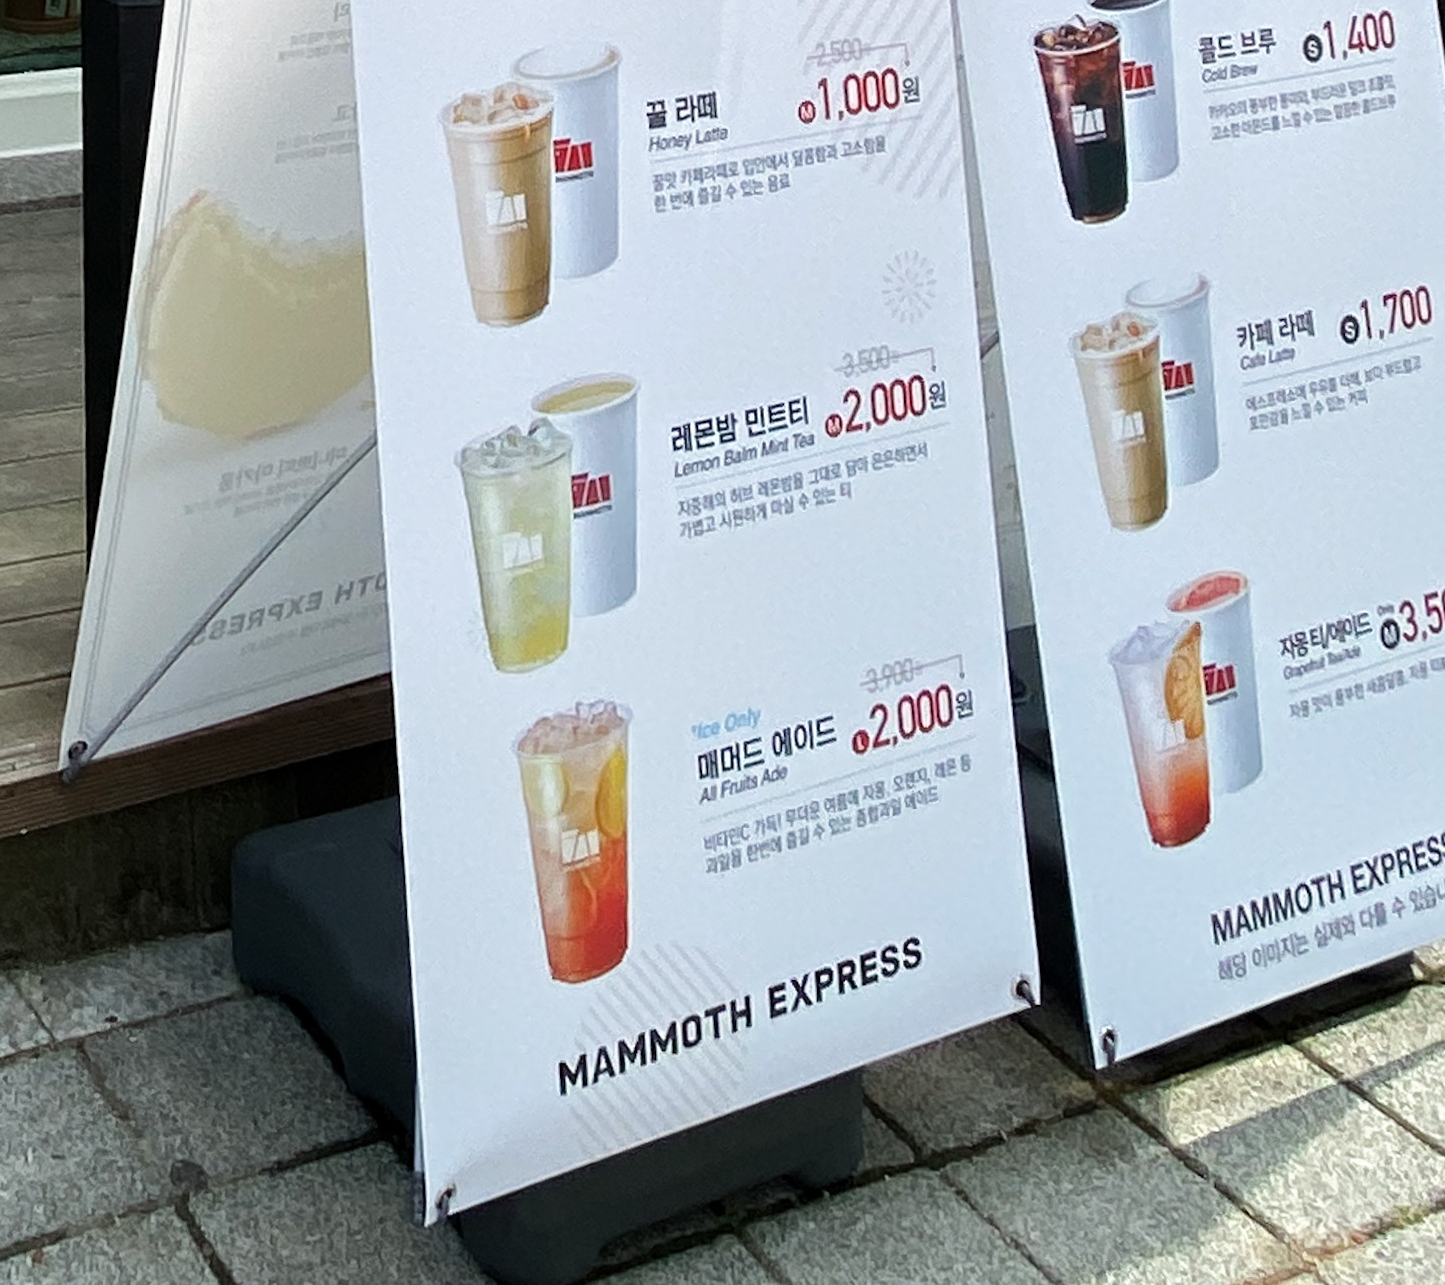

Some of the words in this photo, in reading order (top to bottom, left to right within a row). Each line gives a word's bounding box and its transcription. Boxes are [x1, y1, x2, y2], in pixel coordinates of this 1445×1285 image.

[1198, 35, 1236, 64] 콜드
[1240, 28, 1277, 55] 브루
[1323, 10, 1396, 60] 1,400
[1202, 66, 1228, 84] Cold
[1231, 63, 1258, 79] Brew
[646, 100, 668, 129] 꿀
[675, 91, 718, 123] 라떼
[648, 130, 691, 152] Honey
[724, 183, 736, 201] 수
[1236, 317, 1274, 351] 카페
[1278, 310, 1315, 343] 라떼
[1359, 285, 1434, 341] 1,700
[671, 413, 738, 453] 레몬밤
[745, 396, 809, 438] 민트티
[674, 452, 720, 479] Lemon
[724, 444, 758, 467] Balm
[761, 436, 790, 459] Mint
[793, 430, 816, 451] Tea
[798, 492, 810, 512] 수
[1399, 591, 1445, 642] 3,5
[1279, 631, 1309, 660] 자몽
[724, 707, 762, 733] Only
[698, 737, 765, 781] 매머드
[772, 716, 837, 757] 에이드
[699, 783, 718, 805] All
[720, 772, 759, 799] Fruits
[761, 764, 788, 787] Ade
[1211, 869, 1346, 946] MAMMOTH
[1350, 831, 1445, 896] EXPRES
[1252, 934, 1310, 969] 이미지는
[1391, 895, 1407, 919] 수
[559, 996, 752, 1096] MAMMOTH
[769, 937, 923, 1019] EXPRESS
